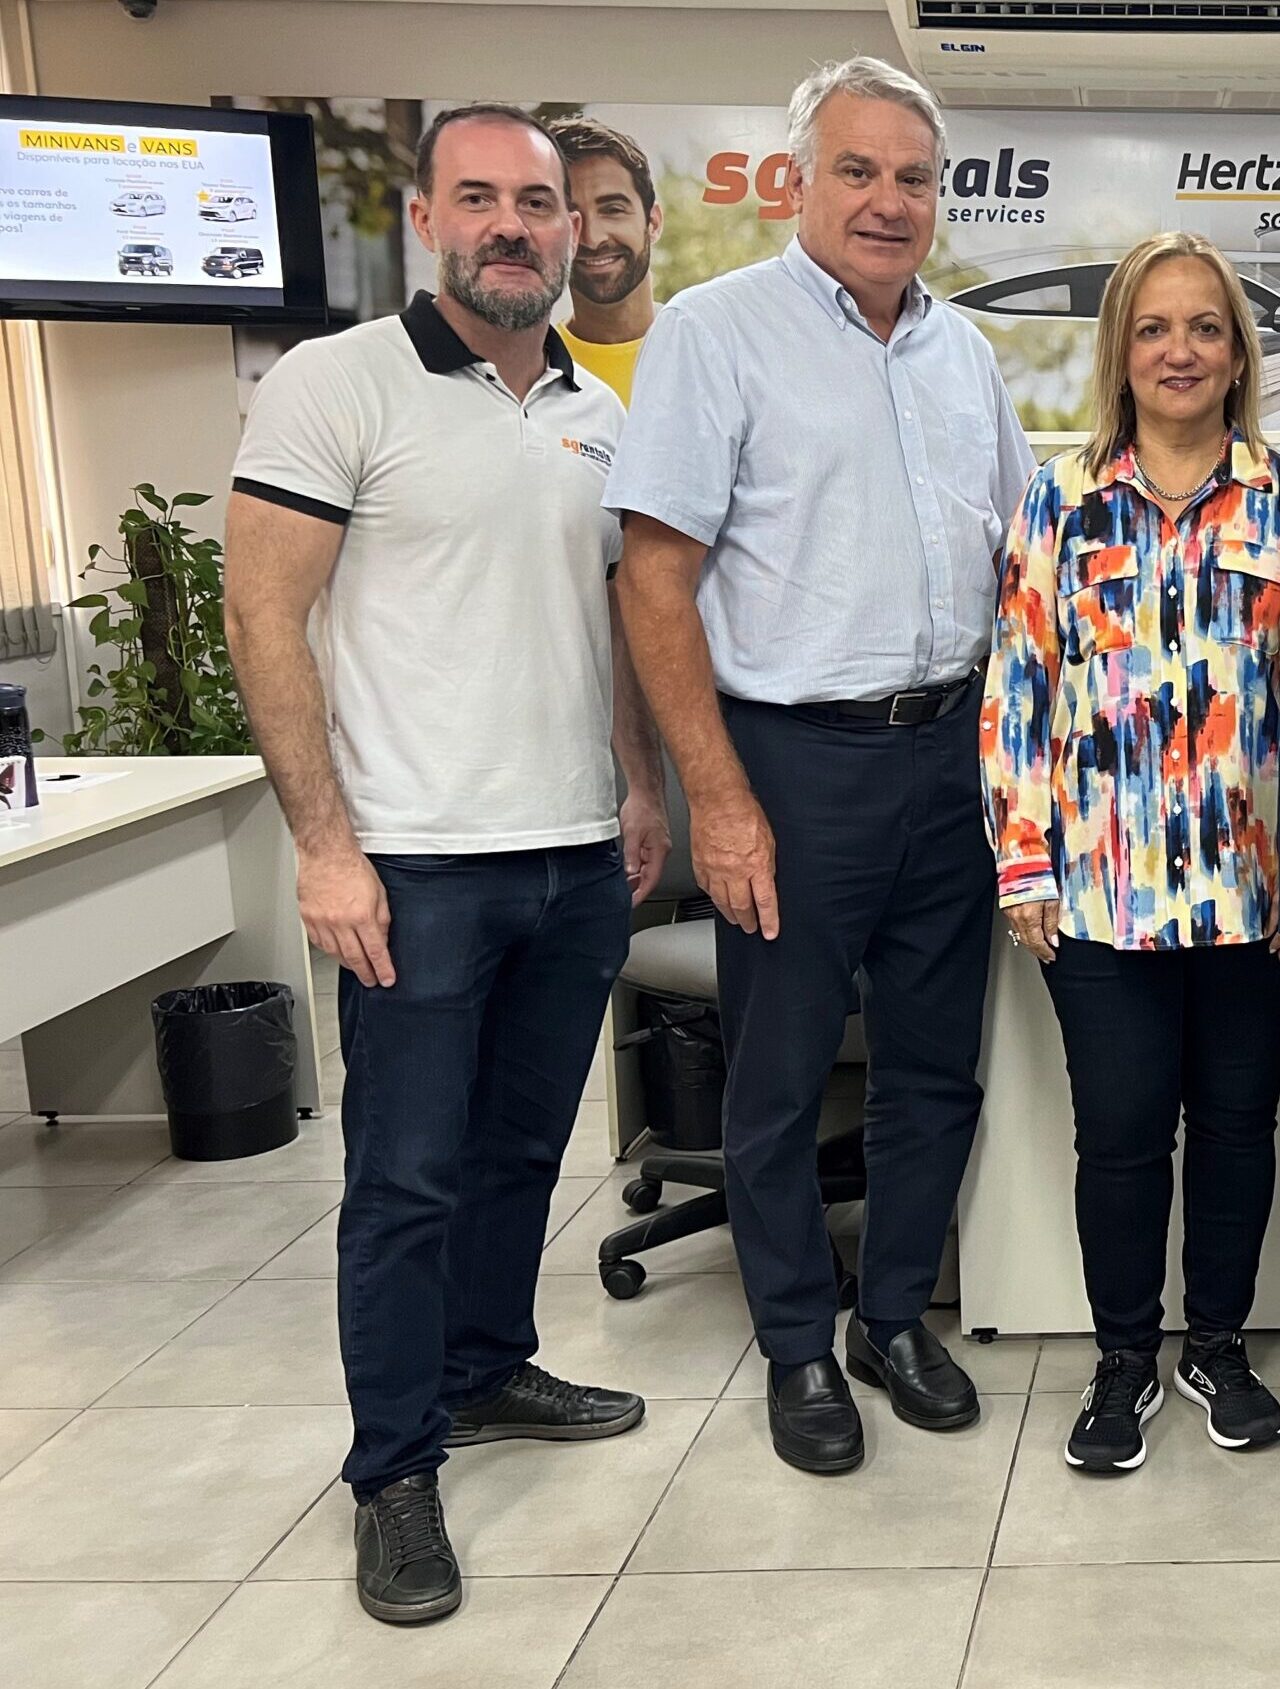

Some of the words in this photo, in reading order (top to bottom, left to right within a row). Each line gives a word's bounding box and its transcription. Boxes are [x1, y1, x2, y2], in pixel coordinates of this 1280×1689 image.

[940, 43, 985, 53] ELGIN
[25, 134, 121, 152] MINIVANS
[126, 142, 137, 153] e
[142, 139, 193, 156] VANS
[83, 156, 110, 165] para
[159, 160, 179, 169] nos
[182, 160, 205, 170] EUA
[54, 188, 69, 197] de
[22, 200, 77, 210] tamanhos
[3, 211, 47, 223] viagens
[947, 204, 1045, 224] services
